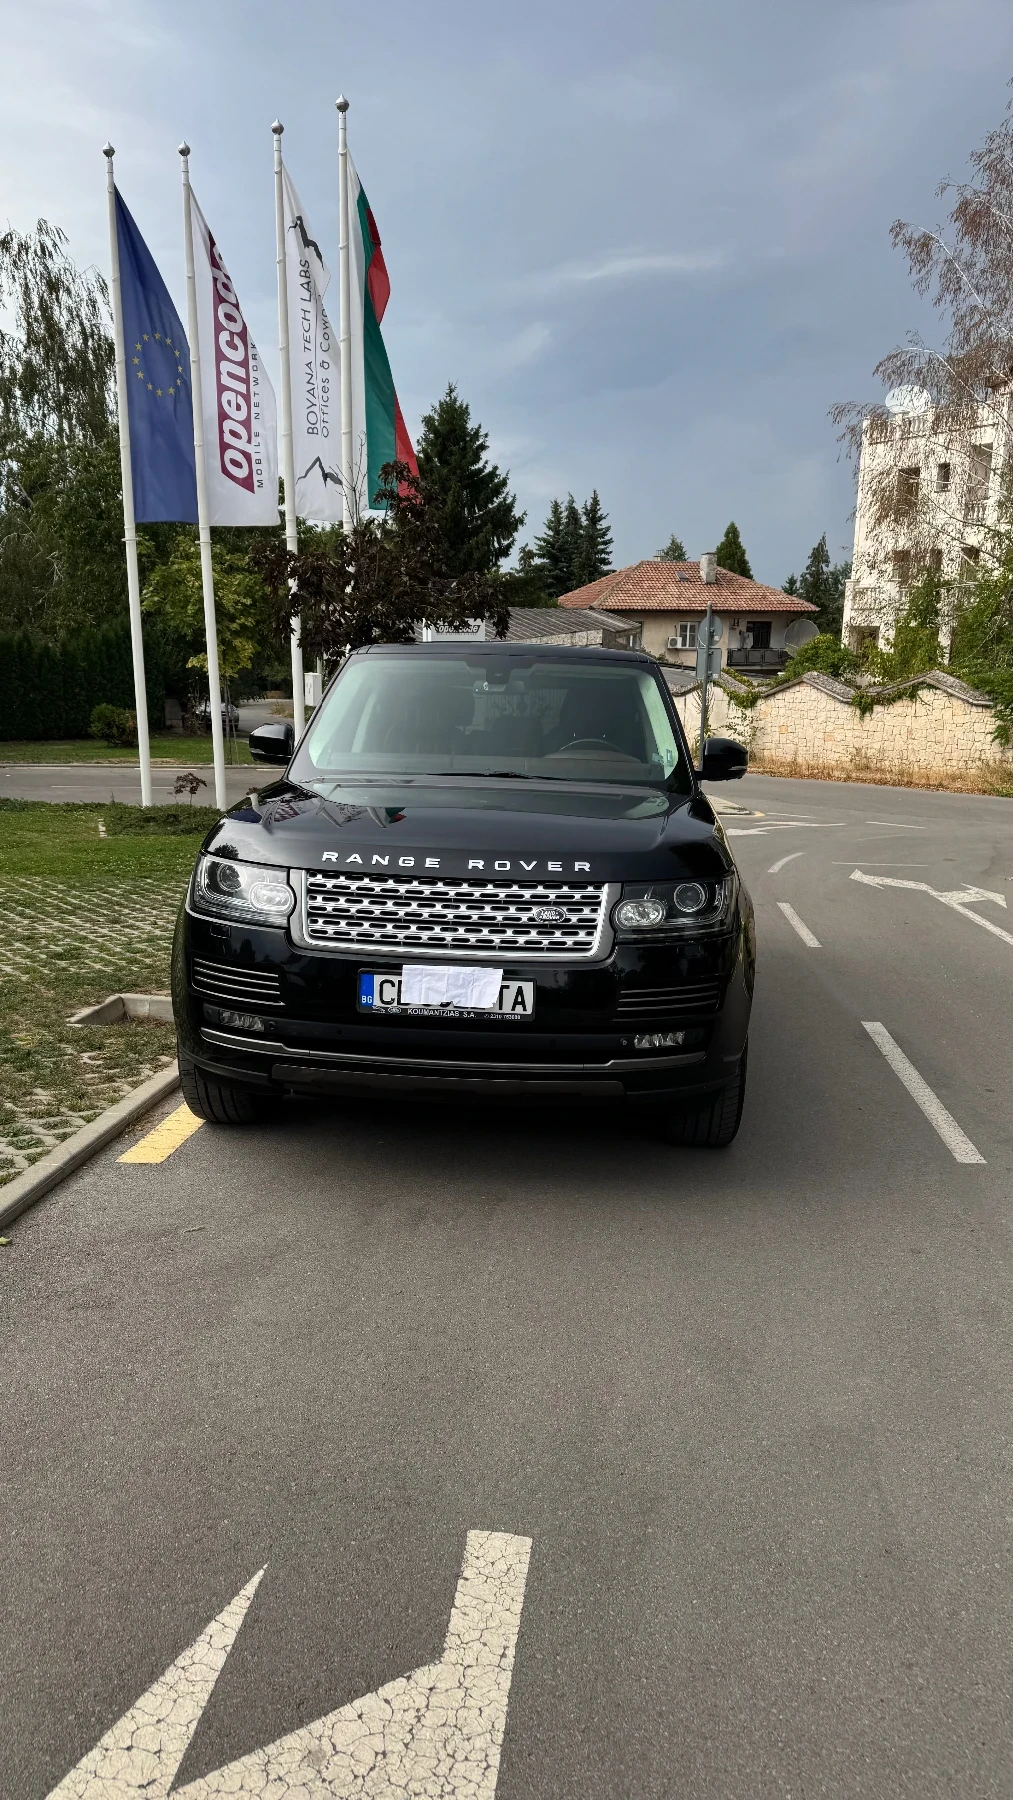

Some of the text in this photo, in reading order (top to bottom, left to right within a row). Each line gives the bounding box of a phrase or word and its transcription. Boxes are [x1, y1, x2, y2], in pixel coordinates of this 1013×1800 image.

[298, 259, 319, 436] BOYANA TECH LABS
[319, 360, 330, 370] &
[253, 431, 264, 489] MOBILE
[321, 851, 592, 872] RANGE ROVER
[361, 995, 373, 1004] BG
